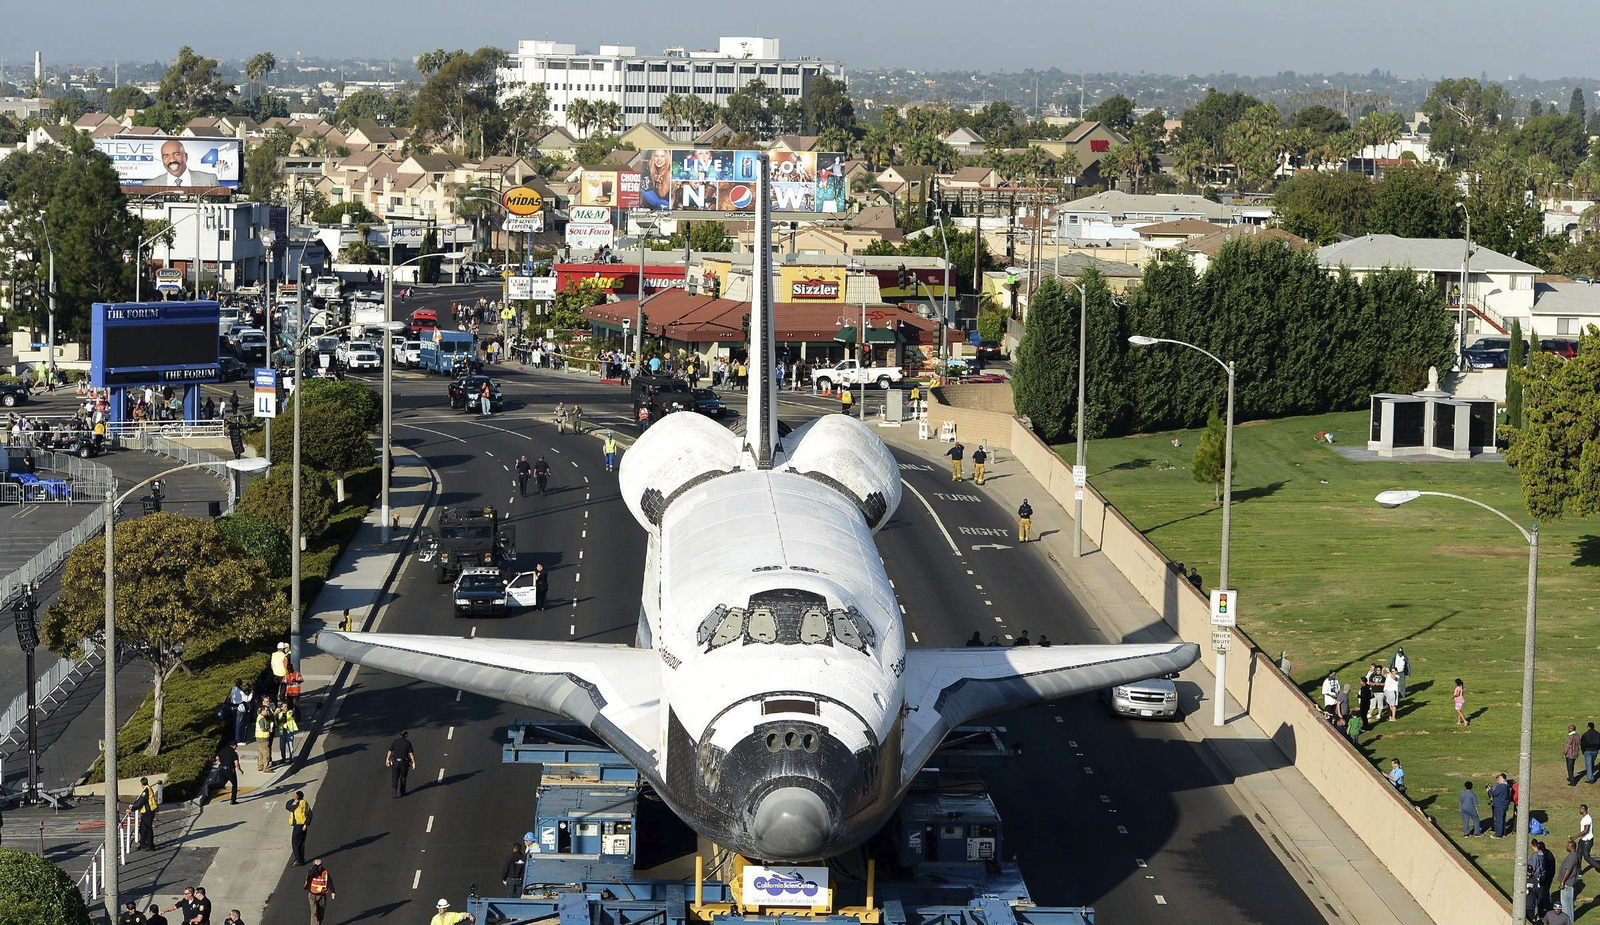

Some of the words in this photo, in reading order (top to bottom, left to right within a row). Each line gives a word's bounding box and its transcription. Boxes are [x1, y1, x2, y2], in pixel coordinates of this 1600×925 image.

[201, 149, 218, 167] 4
[684, 159, 722, 172] LIVE
[770, 160, 805, 174] FOR
[506, 196, 541, 206] MIDAS
[574, 210, 605, 219] M&M
[568, 228, 588, 236] SOUL
[588, 228, 610, 236] FOOD
[643, 278, 669, 288] AUTO
[793, 284, 837, 295] Sizzler
[107, 310, 124, 319] THE
[126, 309, 159, 318] FORUM
[165, 371, 182, 379] THE
[184, 369, 215, 379] FORUM
[259, 397, 271, 412] LL
[933, 493, 981, 502] TURN
[958, 526, 1008, 537] RIGHT
[756, 880, 784, 890] California
